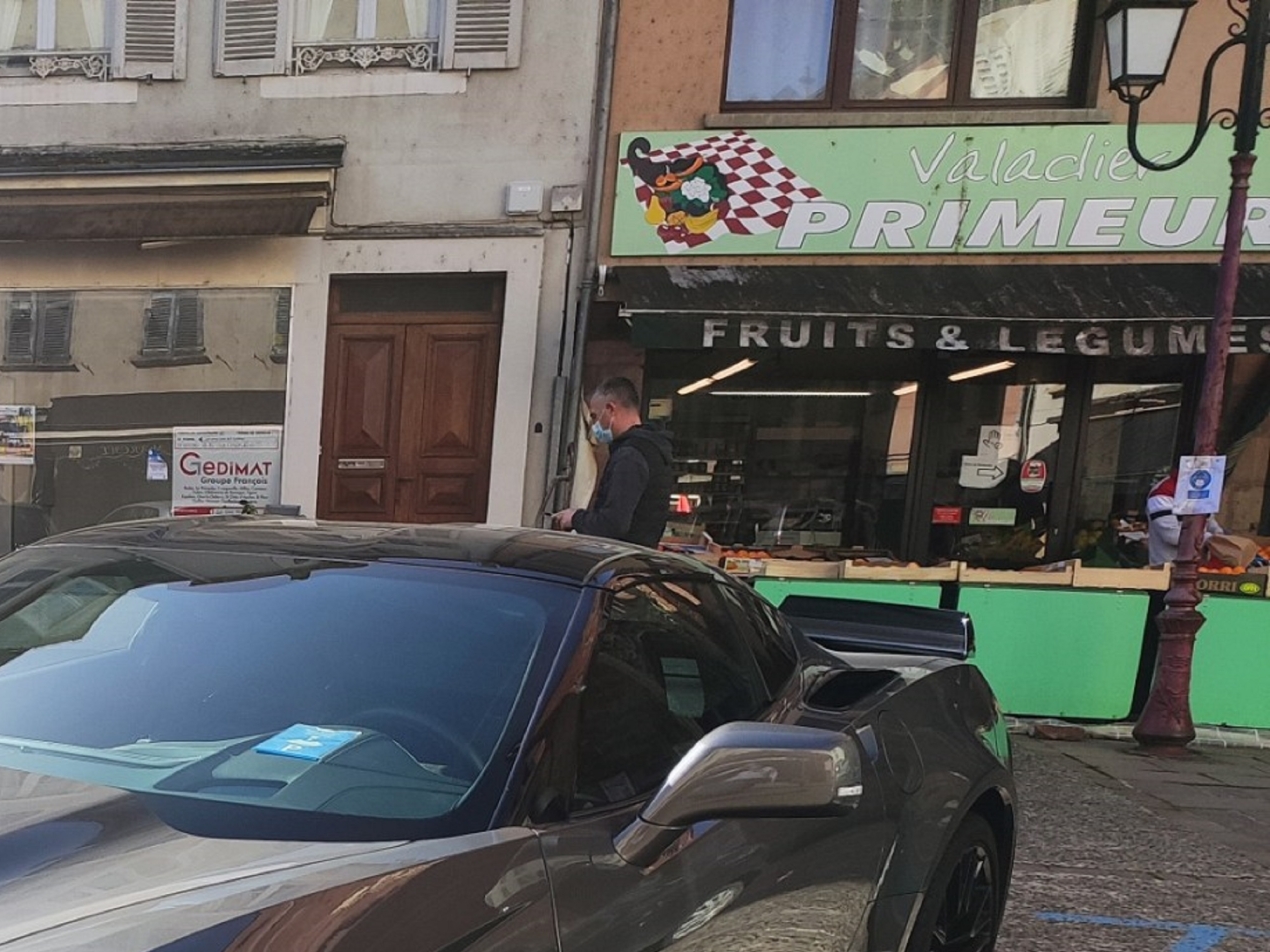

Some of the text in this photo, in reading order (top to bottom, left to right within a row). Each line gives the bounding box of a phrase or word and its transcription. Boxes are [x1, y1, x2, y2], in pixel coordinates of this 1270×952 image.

[908, 131, 1171, 187] Valadier
[702, 318, 916, 349] FRUITS
[935, 324, 970, 350] &
[200, 475, 269, 486] Groupe François
